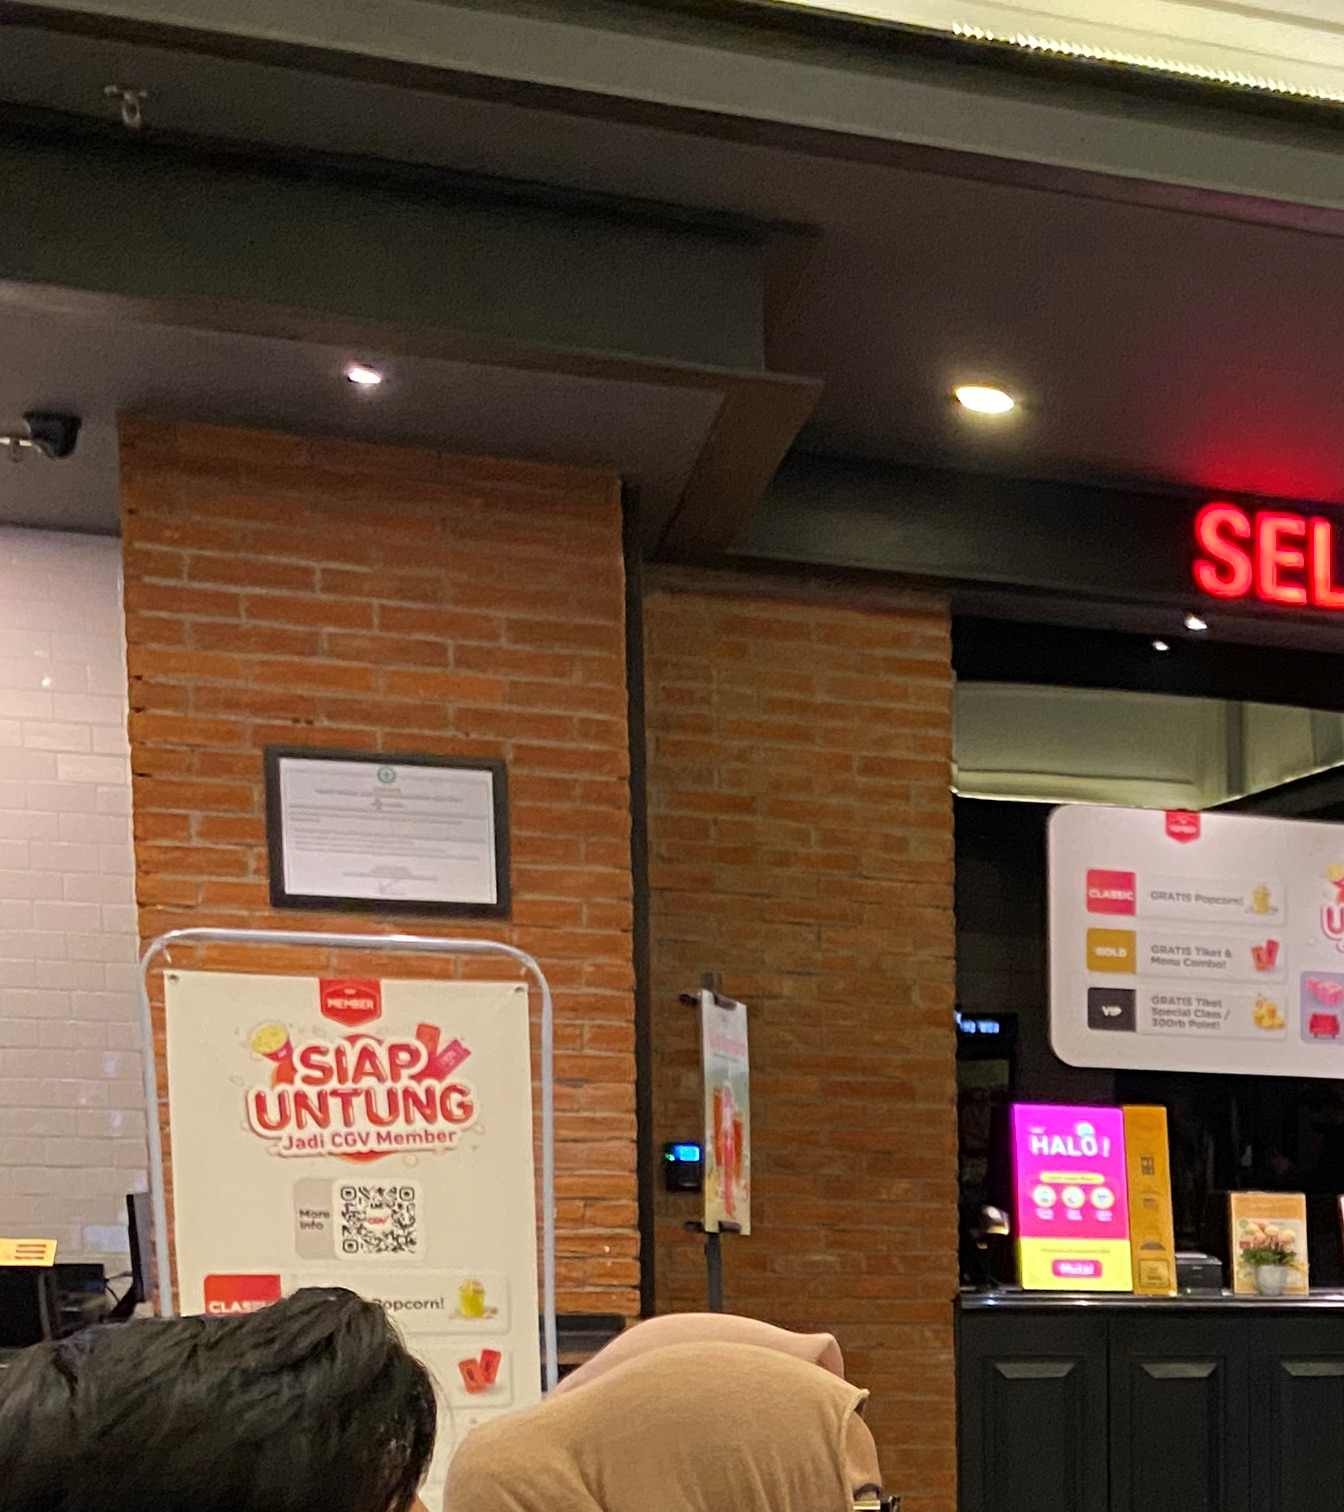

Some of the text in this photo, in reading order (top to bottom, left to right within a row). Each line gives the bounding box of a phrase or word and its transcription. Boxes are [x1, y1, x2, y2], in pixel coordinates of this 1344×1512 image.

[1150, 890, 1192, 902] GRATIS
[1150, 945, 1192, 957] GRATIS
[327, 997, 375, 1011] MEMBER
[299, 1043, 423, 1085] SIAP
[254, 1083, 476, 1131] UNTUNG
[282, 1130, 457, 1151] Jadi CGV Member
